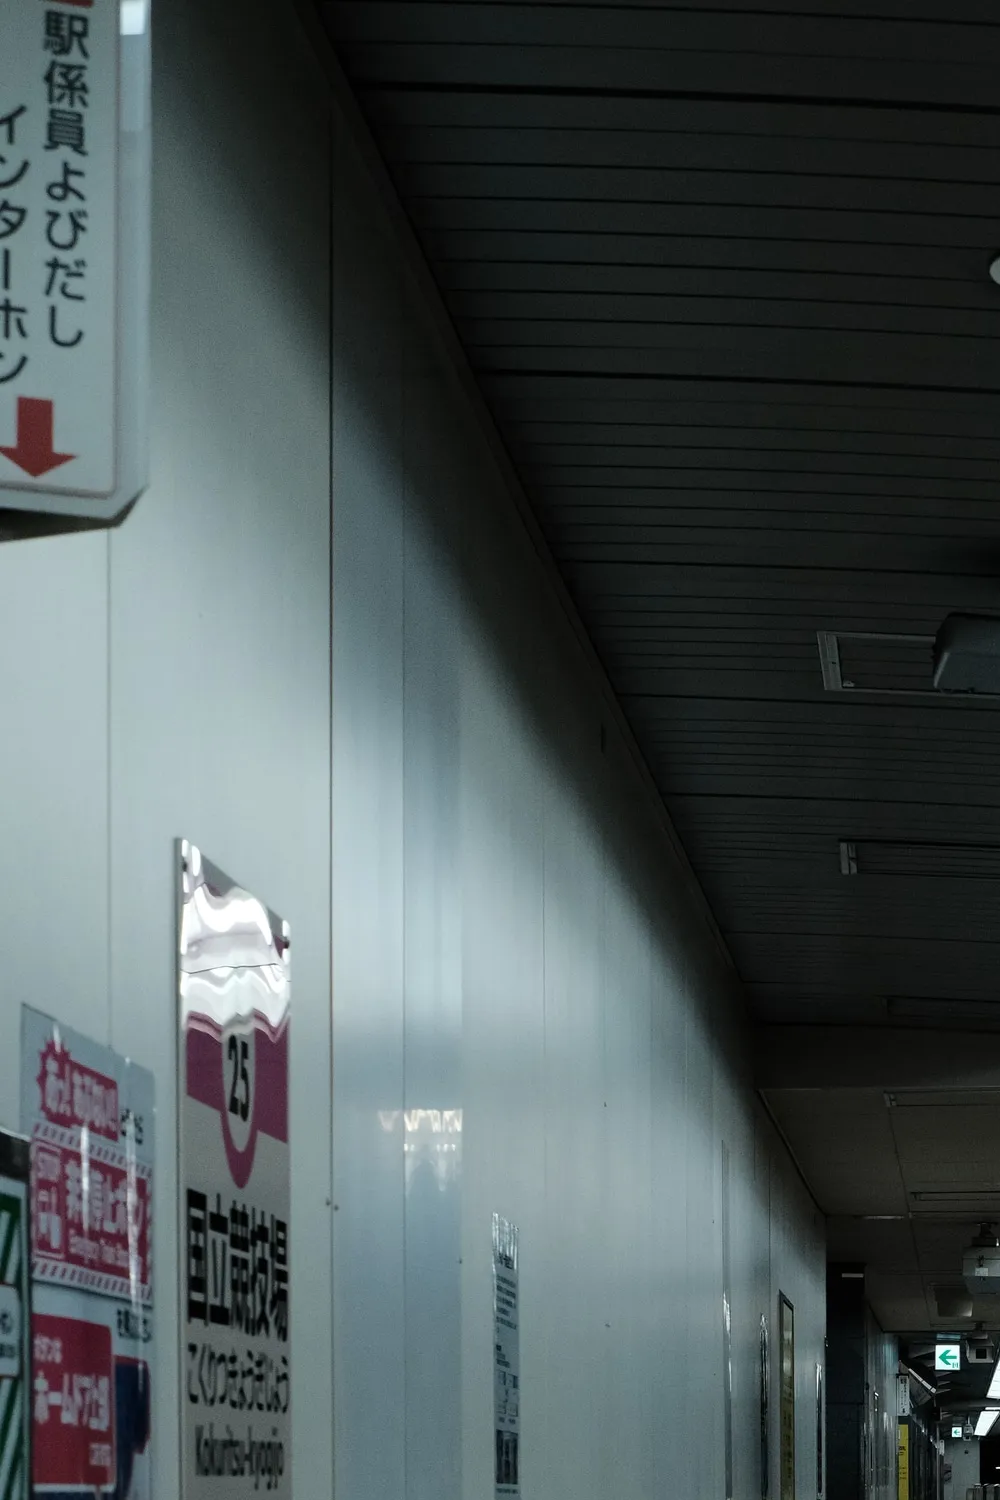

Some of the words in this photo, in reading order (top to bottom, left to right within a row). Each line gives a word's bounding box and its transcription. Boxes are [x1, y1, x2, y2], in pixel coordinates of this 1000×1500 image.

[0, 104, 30, 384] インターホン
[43, 10, 90, 349] 駅係員よびだし
[227, 1033, 250, 1123] 25
[186, 1188, 289, 1343] 国立競技場
